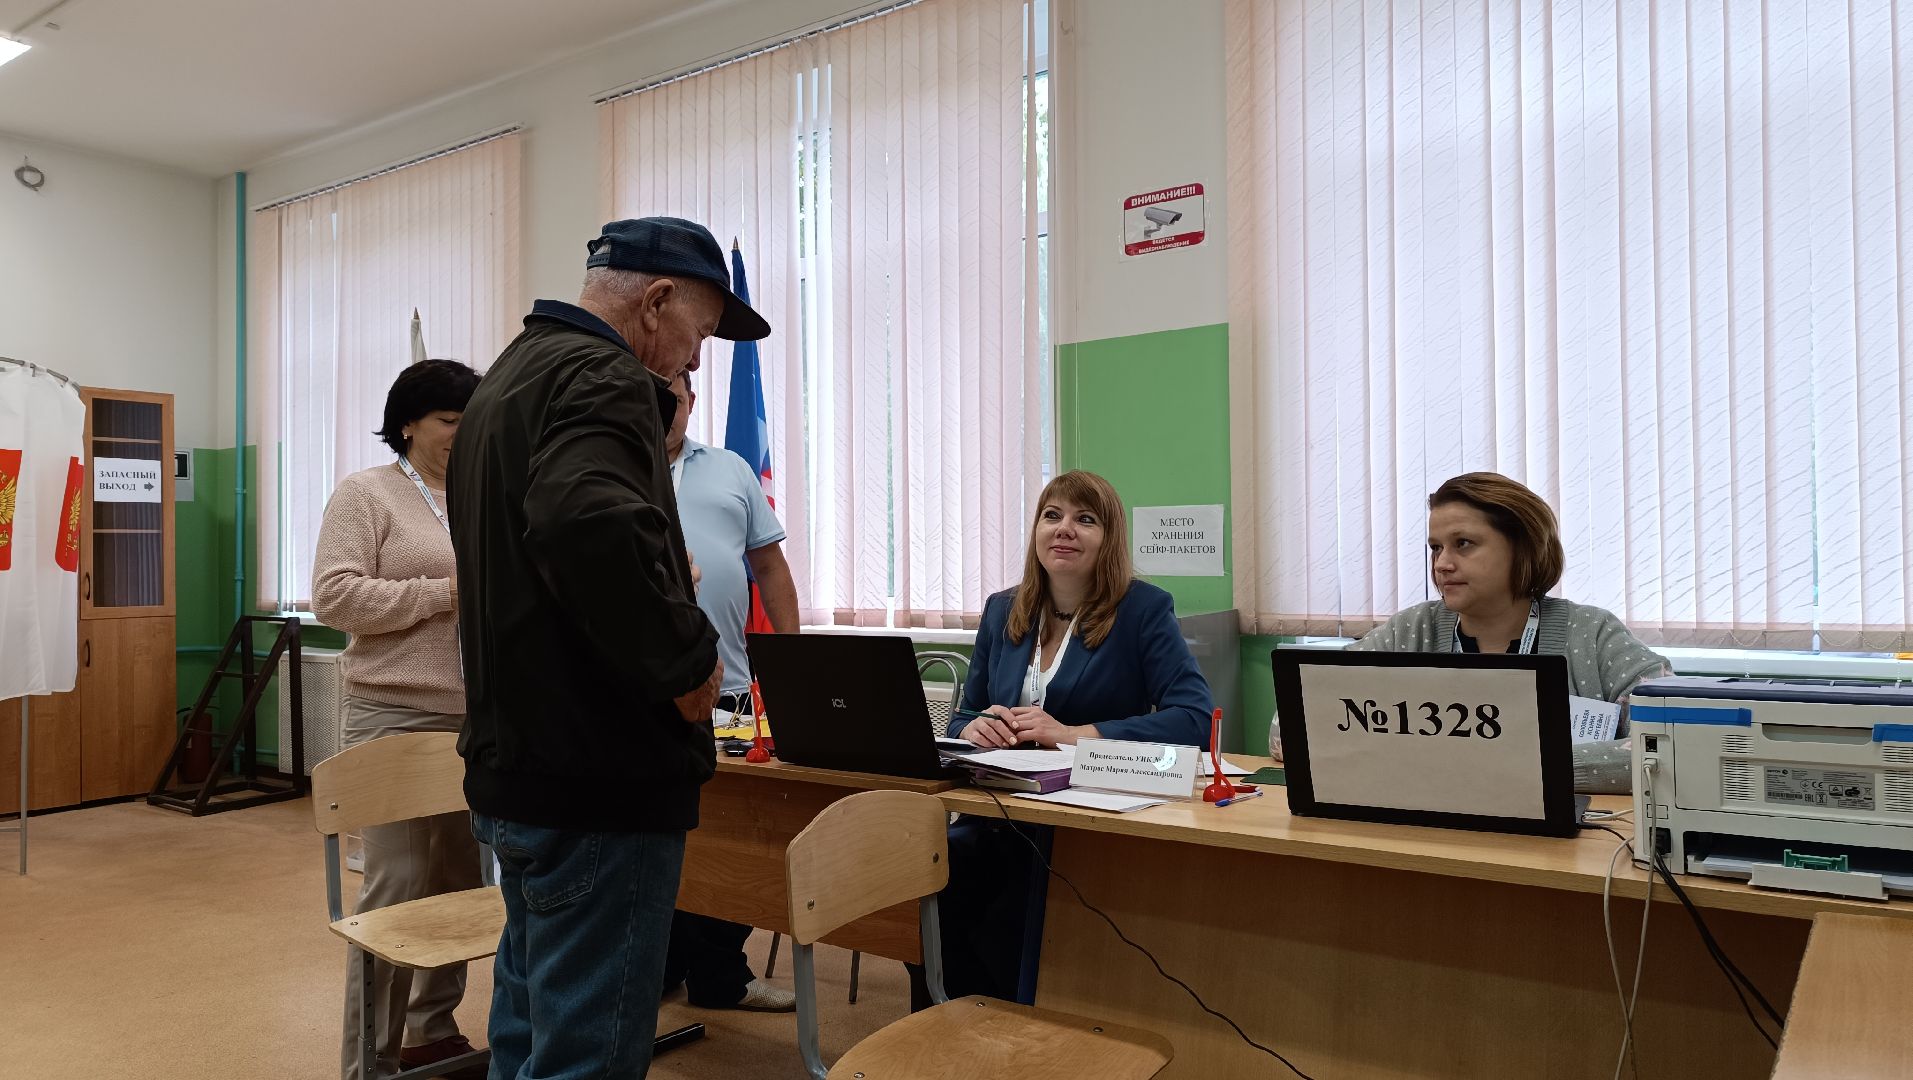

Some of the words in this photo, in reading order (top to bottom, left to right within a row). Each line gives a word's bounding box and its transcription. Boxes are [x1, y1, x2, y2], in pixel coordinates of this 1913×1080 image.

[1131, 186, 1196, 206] ВНИМАНИЕ!!!
[99, 470, 156, 480] ЗАПАСНЫЙ
[99, 482, 136, 491] ВЫХОД
[1160, 517, 1195, 527] МЕСТО
[1151, 531, 1204, 540] ХРАНЕНИЯ
[1139, 543, 1216, 554] СЕЙФ-ПАКЕТОВ
[1337, 698, 1502, 740] №1328
